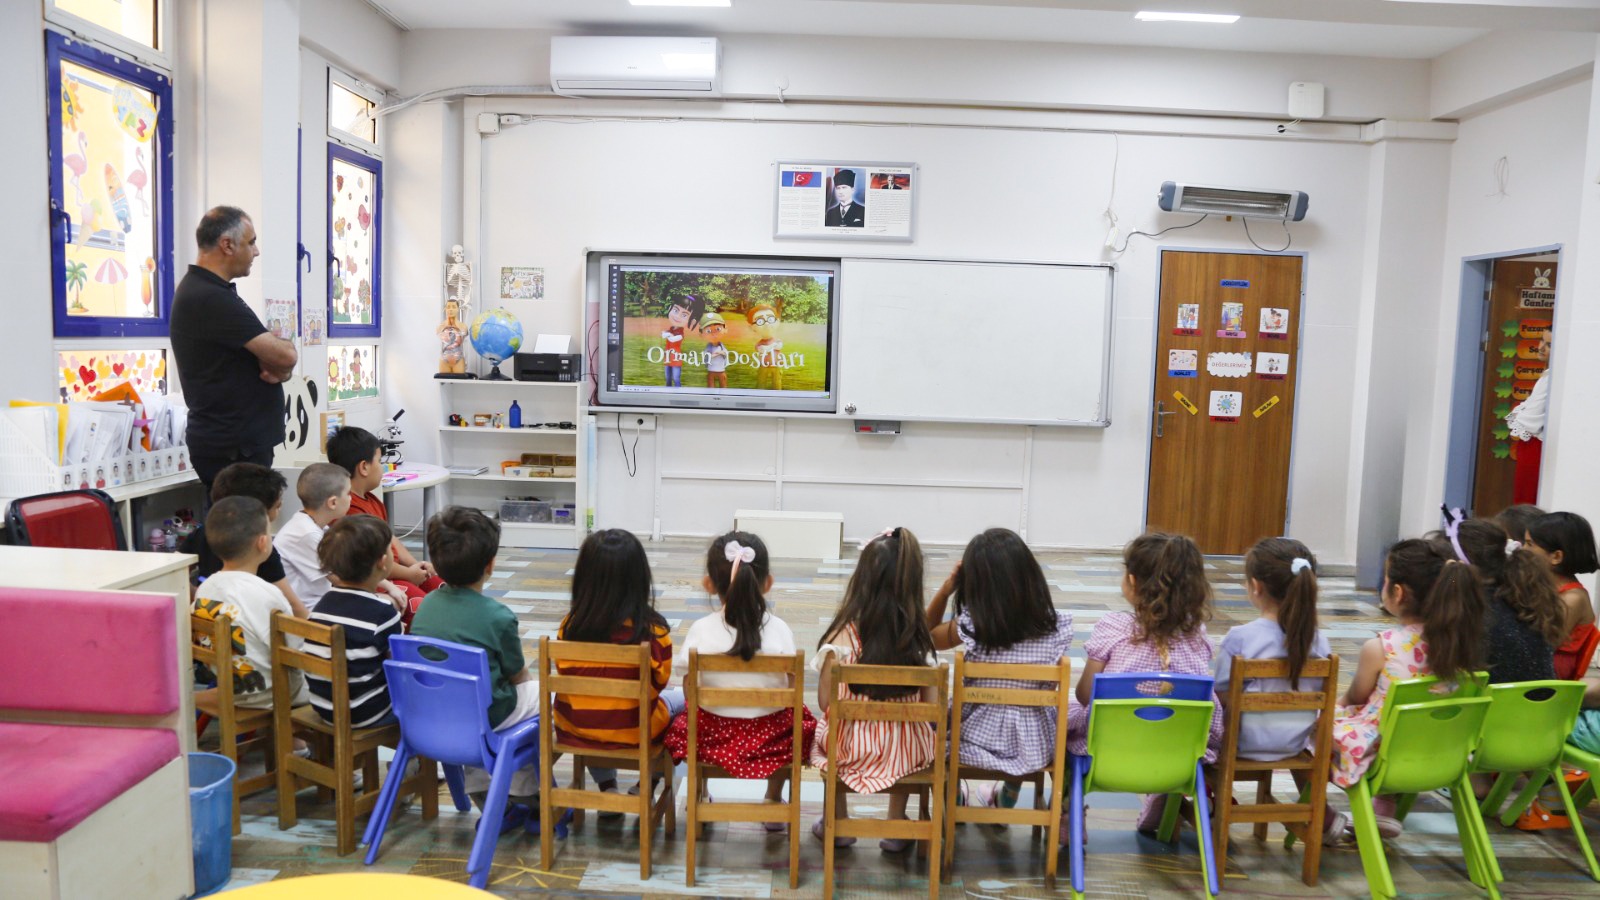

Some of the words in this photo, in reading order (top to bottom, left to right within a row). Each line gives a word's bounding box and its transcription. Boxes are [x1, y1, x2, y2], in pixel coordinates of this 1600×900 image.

[117, 105, 147, 137] YAZ
[647, 346, 712, 367] Orman
[725, 347, 805, 369] Dostları
